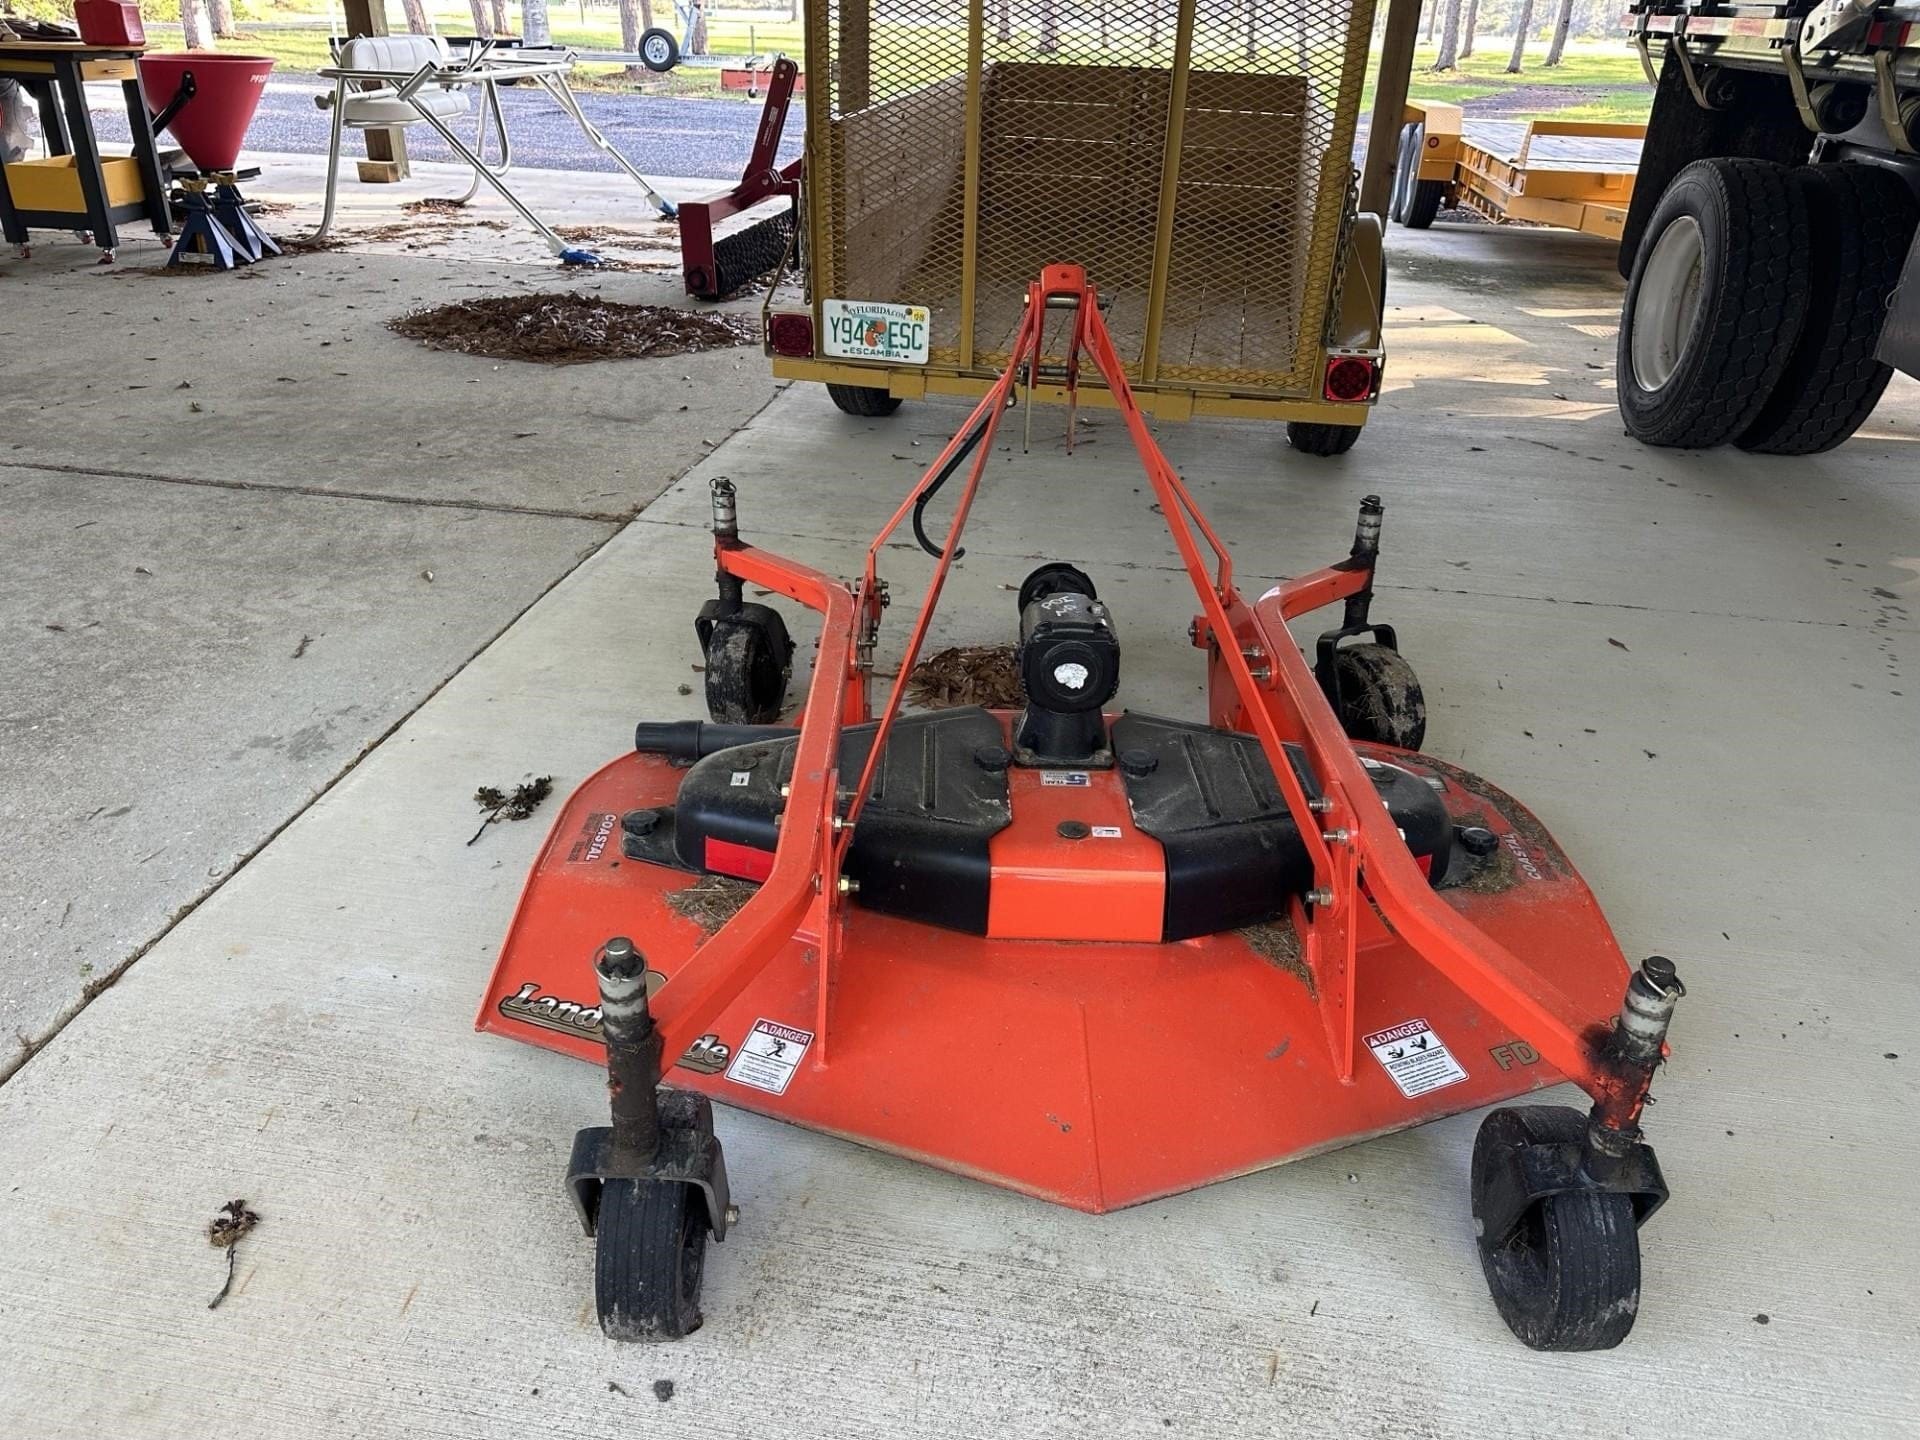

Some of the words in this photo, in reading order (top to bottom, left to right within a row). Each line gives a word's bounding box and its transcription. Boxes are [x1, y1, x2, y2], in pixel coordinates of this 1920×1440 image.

[849, 347, 901, 358] ESCAMBIA
[585, 814, 617, 861] COASTAL
[768, 1025, 810, 1044] DANGER
[1376, 1021, 1427, 1044] DANGER
